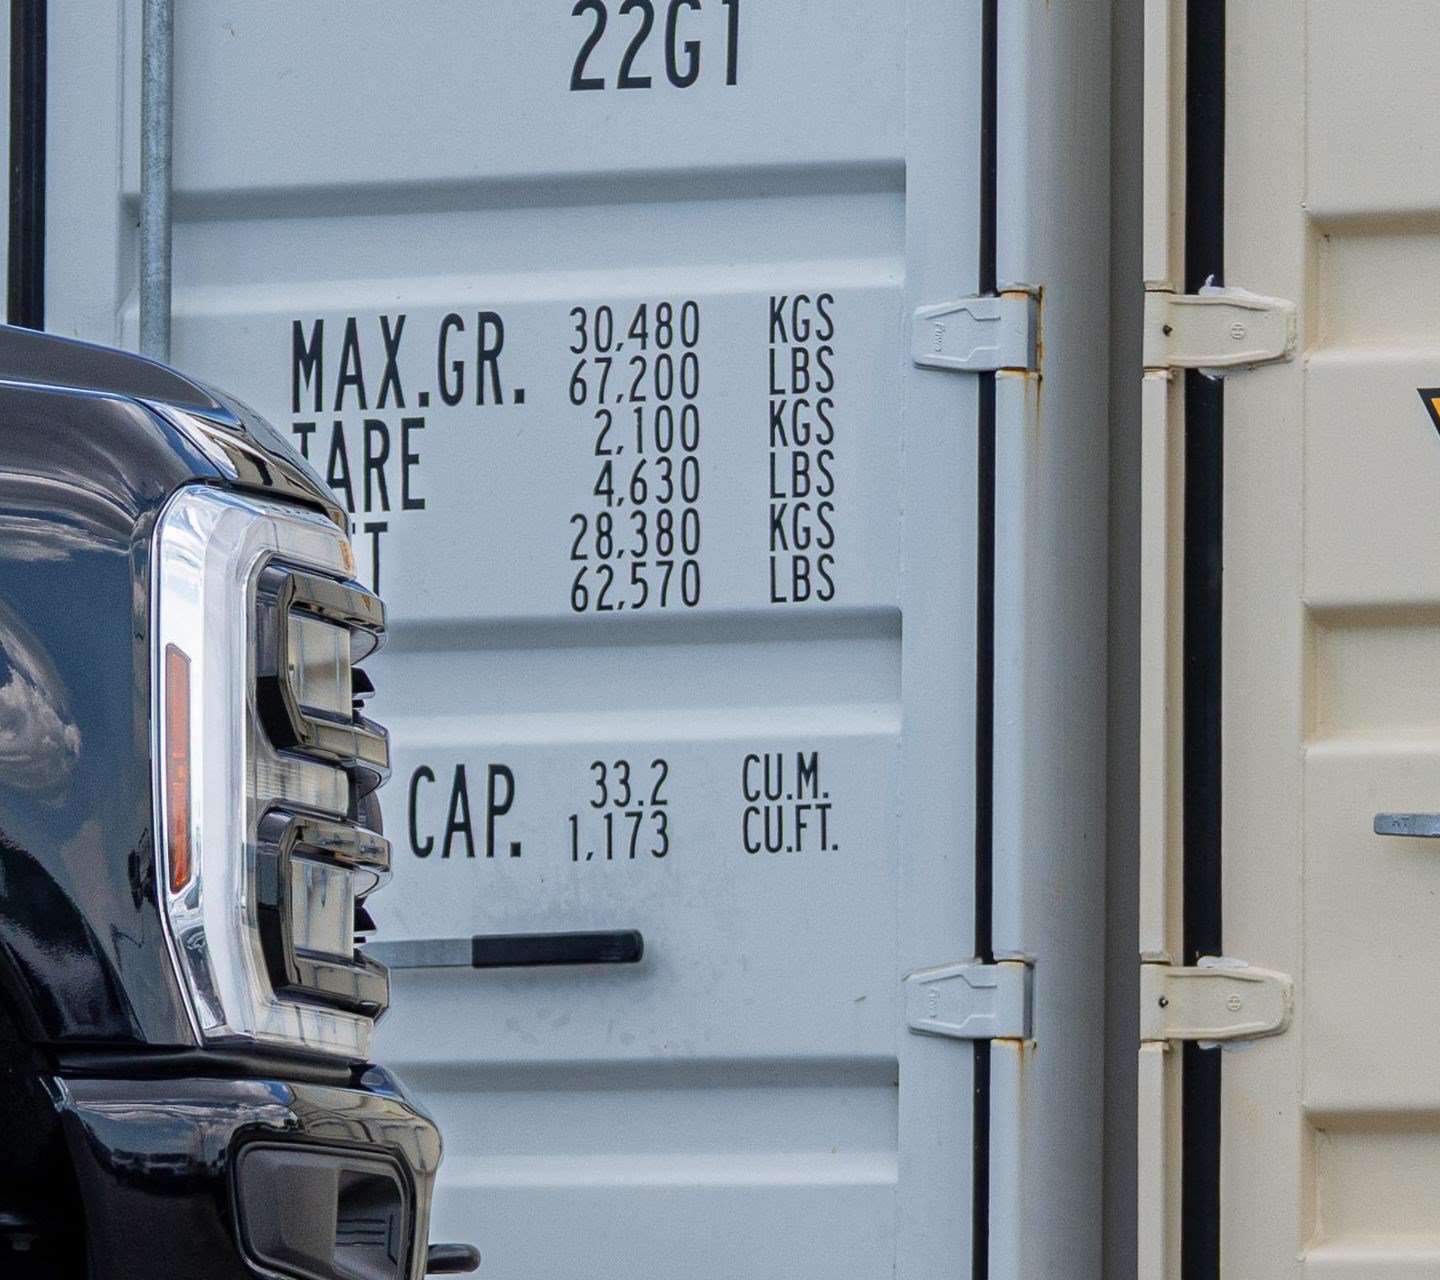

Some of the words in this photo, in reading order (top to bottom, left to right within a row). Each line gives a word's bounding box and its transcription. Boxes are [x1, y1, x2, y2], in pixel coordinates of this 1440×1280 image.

[292, 311, 525, 413] MAX.GR.
[569, 300, 700, 354] 30,480
[768, 293, 835, 344] KGS
[569, 350, 700, 406] 67,200
[768, 344, 835, 396] LBS
[292, 417, 426, 514] TARE
[594, 404, 700, 457] 2,100
[768, 397, 835, 448] KGS
[594, 456, 700, 508] 4,630
[768, 449, 835, 500] LBS
[569, 508, 701, 561] 28,380
[768, 501, 835, 551] KGS
[569, 560, 701, 613] 62,570
[768, 554, 835, 603] LBS
[408, 763, 522, 859] CAP.
[590, 759, 669, 809] 33.2
[743, 751, 829, 802] CU.M.
[568, 810, 670, 862] 1,173
[743, 803, 839, 854] CU.FT.
